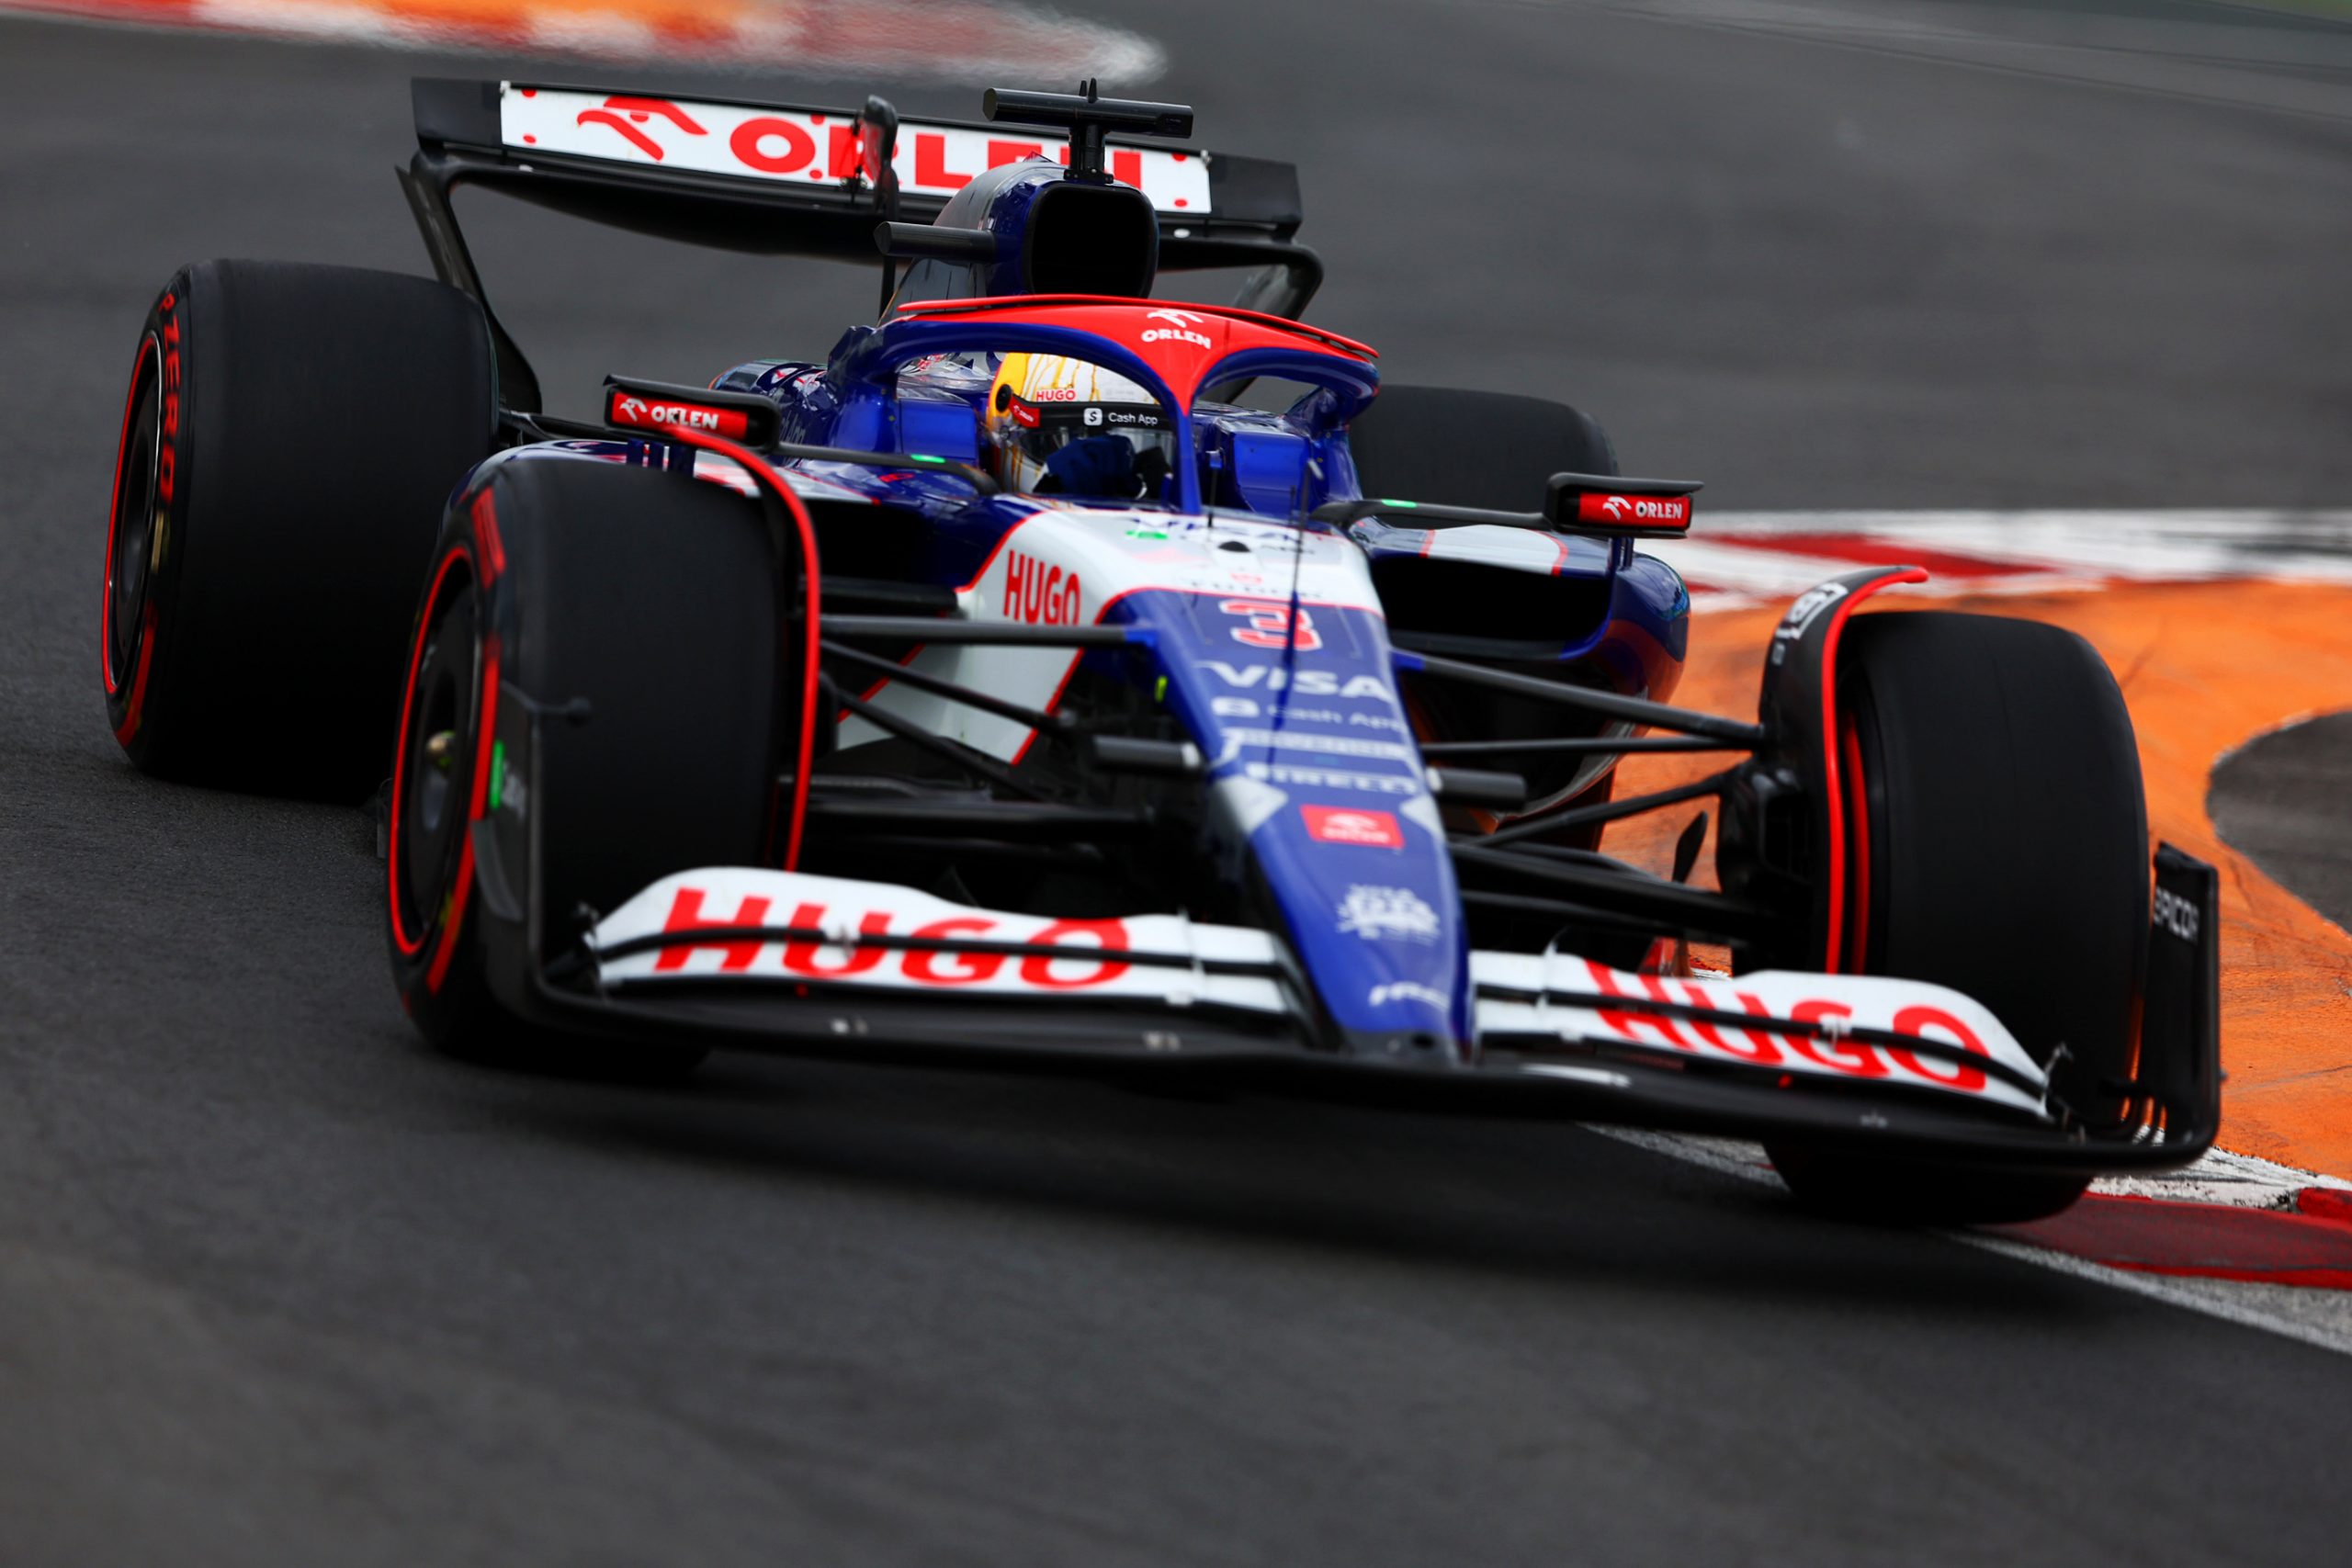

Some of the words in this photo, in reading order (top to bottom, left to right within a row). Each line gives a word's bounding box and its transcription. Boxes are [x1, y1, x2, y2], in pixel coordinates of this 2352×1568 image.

[1141, 328, 1211, 349] ORLEN
[1035, 389, 1076, 401] HUGO
[651, 406, 718, 430] ORLEN
[1108, 412, 1136, 423] Cash
[1137, 414, 1159, 425] App
[1635, 501, 1683, 520] ORLEN
[1003, 549, 1081, 626] HUGO
[1219, 600, 1322, 650] 3
[1194, 660, 1393, 705] VISA
[653, 886, 1130, 992] HUGO
[1583, 957, 1990, 1092] HUGO
